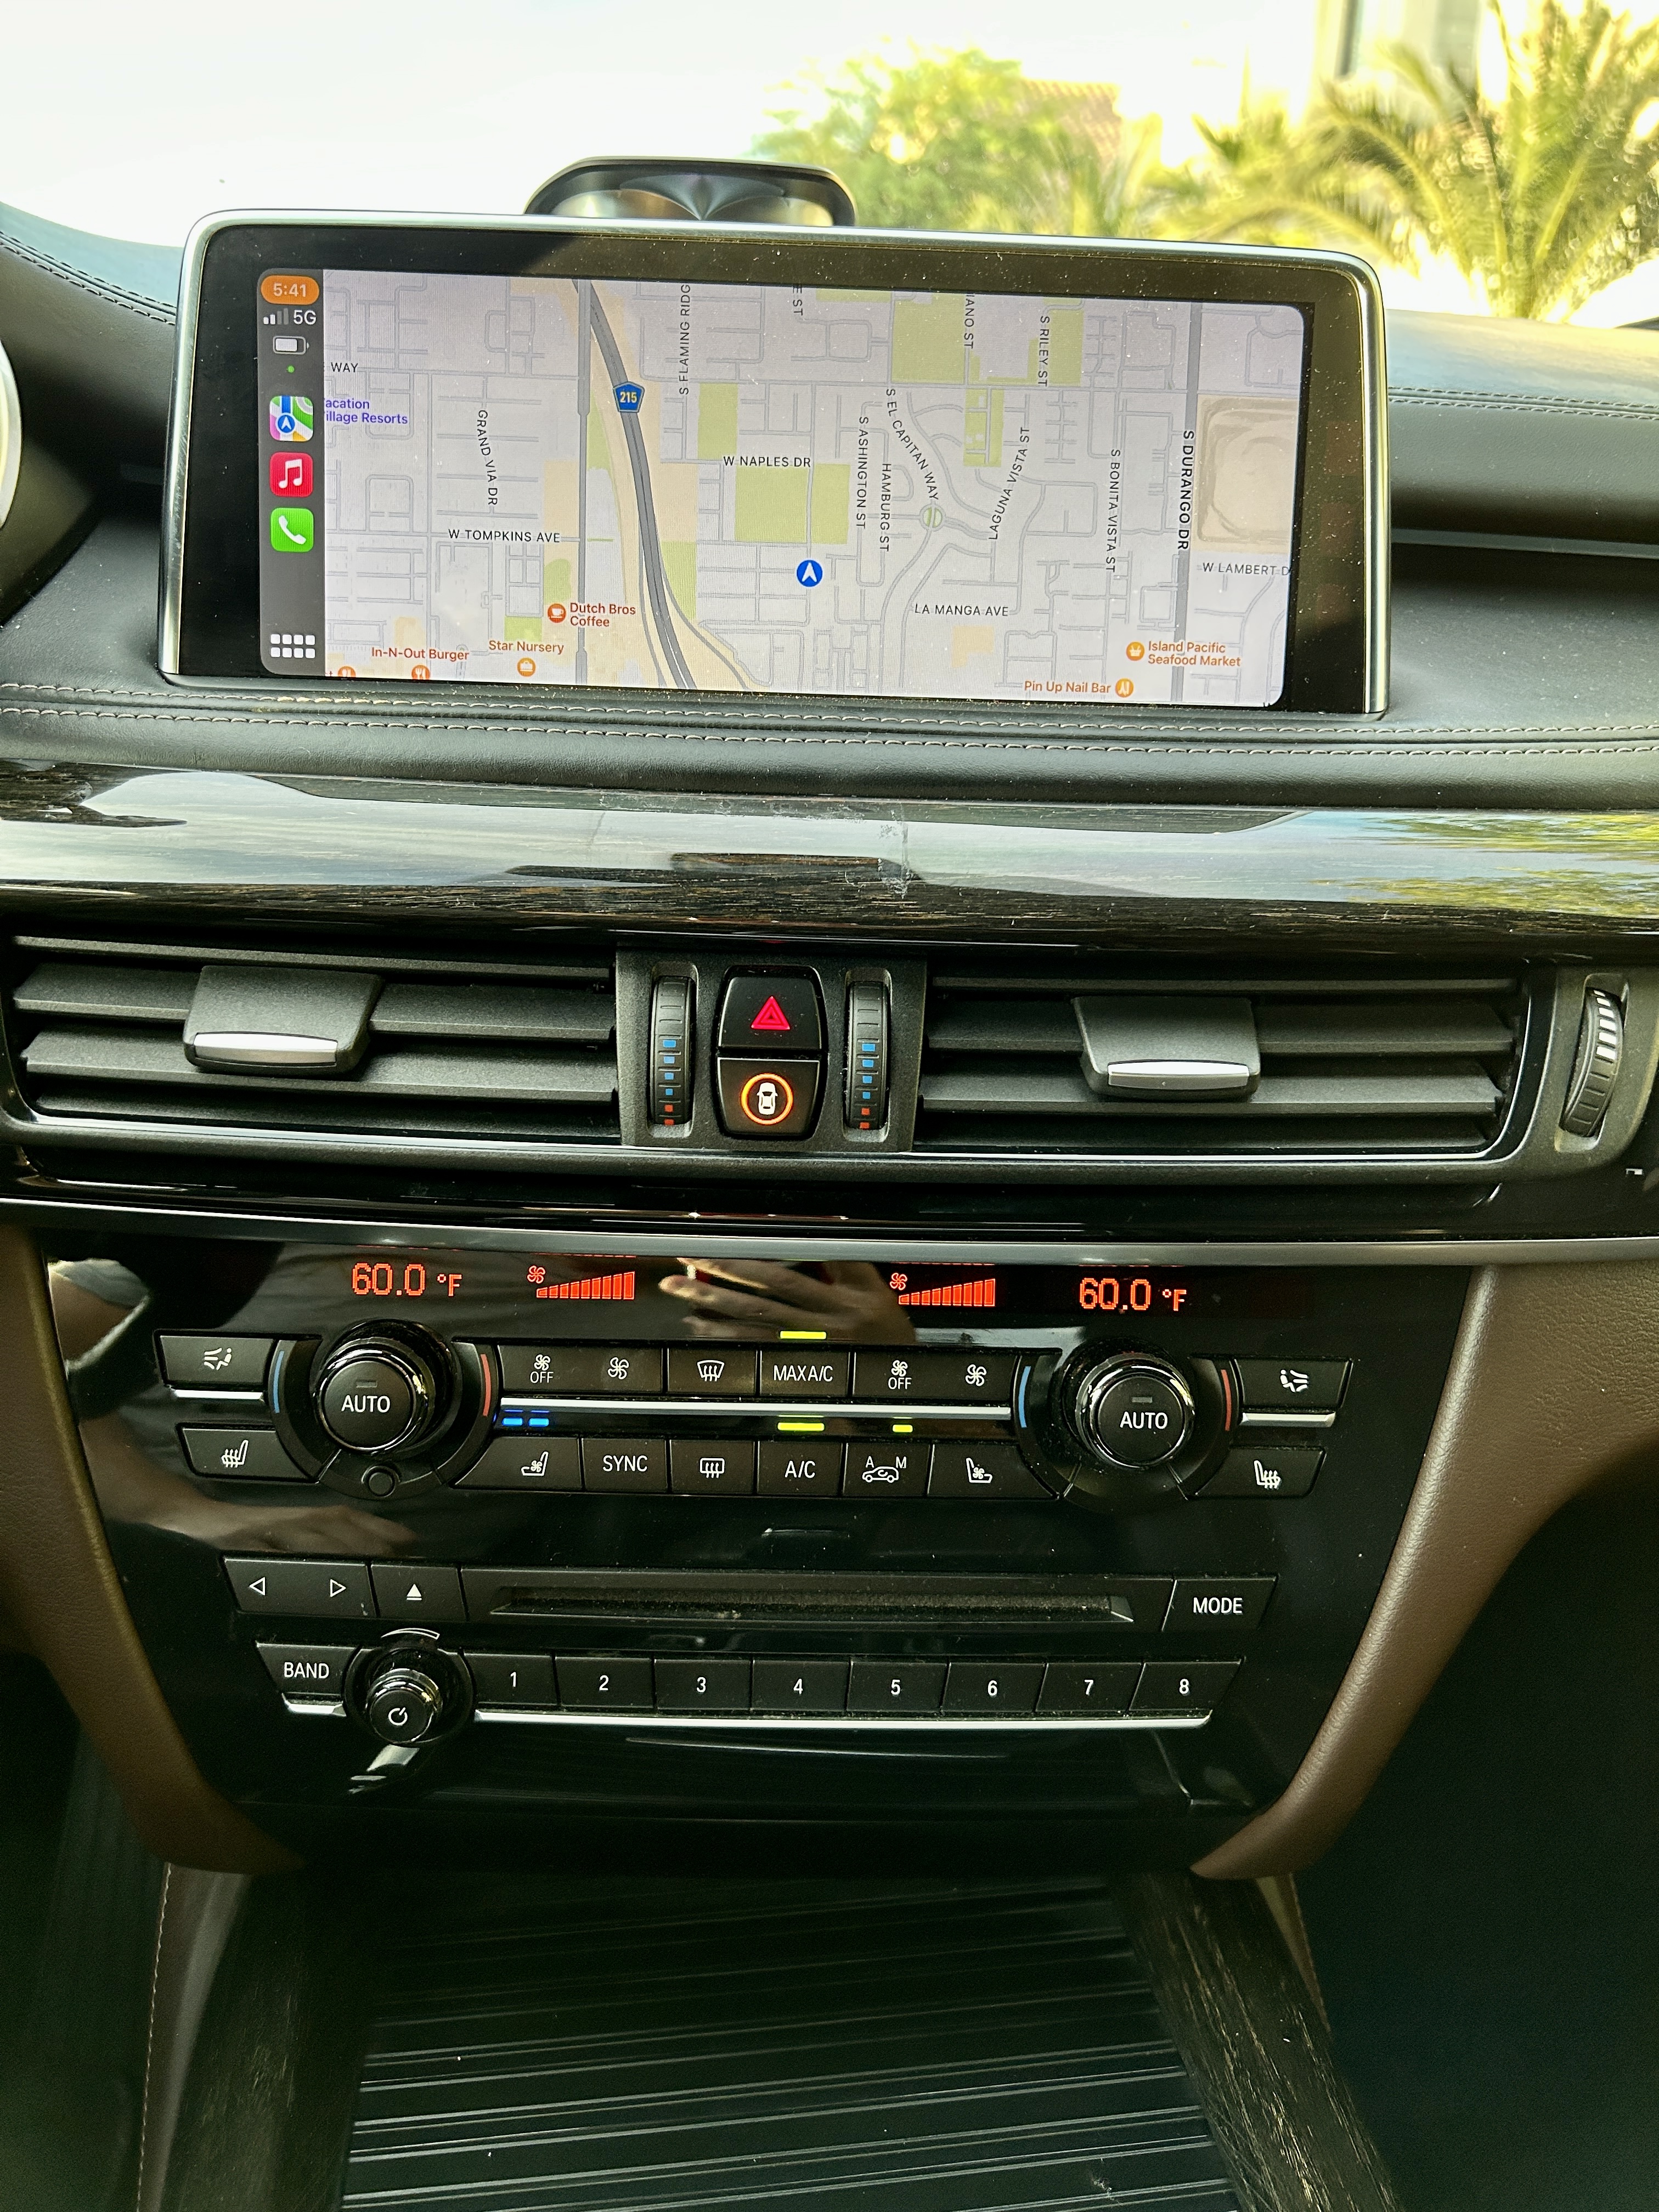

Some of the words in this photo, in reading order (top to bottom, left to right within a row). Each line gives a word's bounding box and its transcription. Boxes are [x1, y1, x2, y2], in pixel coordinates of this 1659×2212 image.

[273, 283, 307, 297] 5:41
[792, 299, 803, 316] ST
[294, 309, 317, 325] 5G
[1040, 315, 1050, 324] S
[963, 332, 974, 349] ST
[1039, 329, 1049, 365] RILEY
[679, 321, 690, 382] FLAMING
[331, 362, 358, 373] WAY
[1037, 370, 1048, 387] ST
[619, 391, 637, 403] 215
[886, 388, 896, 397] S
[324, 397, 370, 409] acation
[887, 401, 898, 417] EL
[324, 410, 358, 425] illage
[362, 412, 408, 424] Resorts
[477, 410, 491, 456] GRAND
[1183, 430, 1194, 439] S
[892, 420, 929, 470] CAPITAN
[723, 456, 735, 466] W
[740, 456, 789, 467] NAPLES
[794, 457, 811, 467] DR
[856, 428, 868, 508] ASHINGTON
[485, 459, 497, 483] VIA
[924, 471, 939, 500] WAY
[988, 489, 1013, 540] LAGUNA
[1007, 449, 1028, 482] VISTA
[1019, 427, 1030, 443] ST
[1108, 462, 1120, 510] BONITA
[1179, 445, 1194, 523] DURANGO
[488, 488, 498, 505] DR
[880, 463, 891, 531] HAMBURG
[856, 513, 866, 529] ST
[448, 529, 460, 539] W
[465, 529, 532, 542] TOMPKINS
[537, 532, 560, 543] AVE
[1106, 515, 1118, 552] VISTA
[1177, 529, 1189, 549] DR
[879, 536, 889, 552] ST
[1105, 556, 1116, 573] ST
[1203, 562, 1214, 572] W
[1218, 563, 1277, 575] LAMBERT
[570, 602, 605, 614] Dutch
[609, 603, 636, 615] Bros
[915, 603, 930, 614] LA
[935, 605, 980, 616] MANGA
[985, 606, 1008, 617] AVE
[570, 615, 610, 627] Coffee
[372, 647, 426, 659] In-N-Out
[429, 649, 470, 662] Burger
[489, 640, 514, 651] Star
[517, 641, 564, 655] Nursery
[1148, 640, 1183, 652] Island
[1187, 642, 1226, 653] Pacific
[1148, 653, 1197, 665] Seafood
[1200, 656, 1241, 667] Market
[1024, 680, 1042, 691] Pin
[1046, 681, 1063, 694] Up
[1066, 682, 1088, 692] Nail
[1091, 682, 1111, 693] Bar
[352, 1262, 425, 1296] 60.0
[1080, 1277, 1150, 1311] 60.0
[530, 1371, 554, 1384] OFF
[808, 1365, 833, 1382] A/C
[888, 1376, 912, 1390] OFF
[341, 1395, 391, 1413] AUTO
[1120, 1411, 1168, 1429] AUTO
[602, 1455, 648, 1472] SYNC
[785, 1460, 816, 1479] A/C
[866, 1455, 874, 1468] A
[895, 1455, 907, 1468] M
[1193, 1597, 1243, 1615] MODE
[284, 1662, 329, 1679] BAND
[510, 1672, 516, 1688] 1
[599, 1675, 609, 1691] 2
[696, 1677, 706, 1693] 3
[793, 1678, 803, 1695] 4
[890, 1679, 901, 1696] 5
[988, 1680, 998, 1696] 6
[1084, 1679, 1094, 1696] 7
[1179, 1678, 1189, 1694] 8
